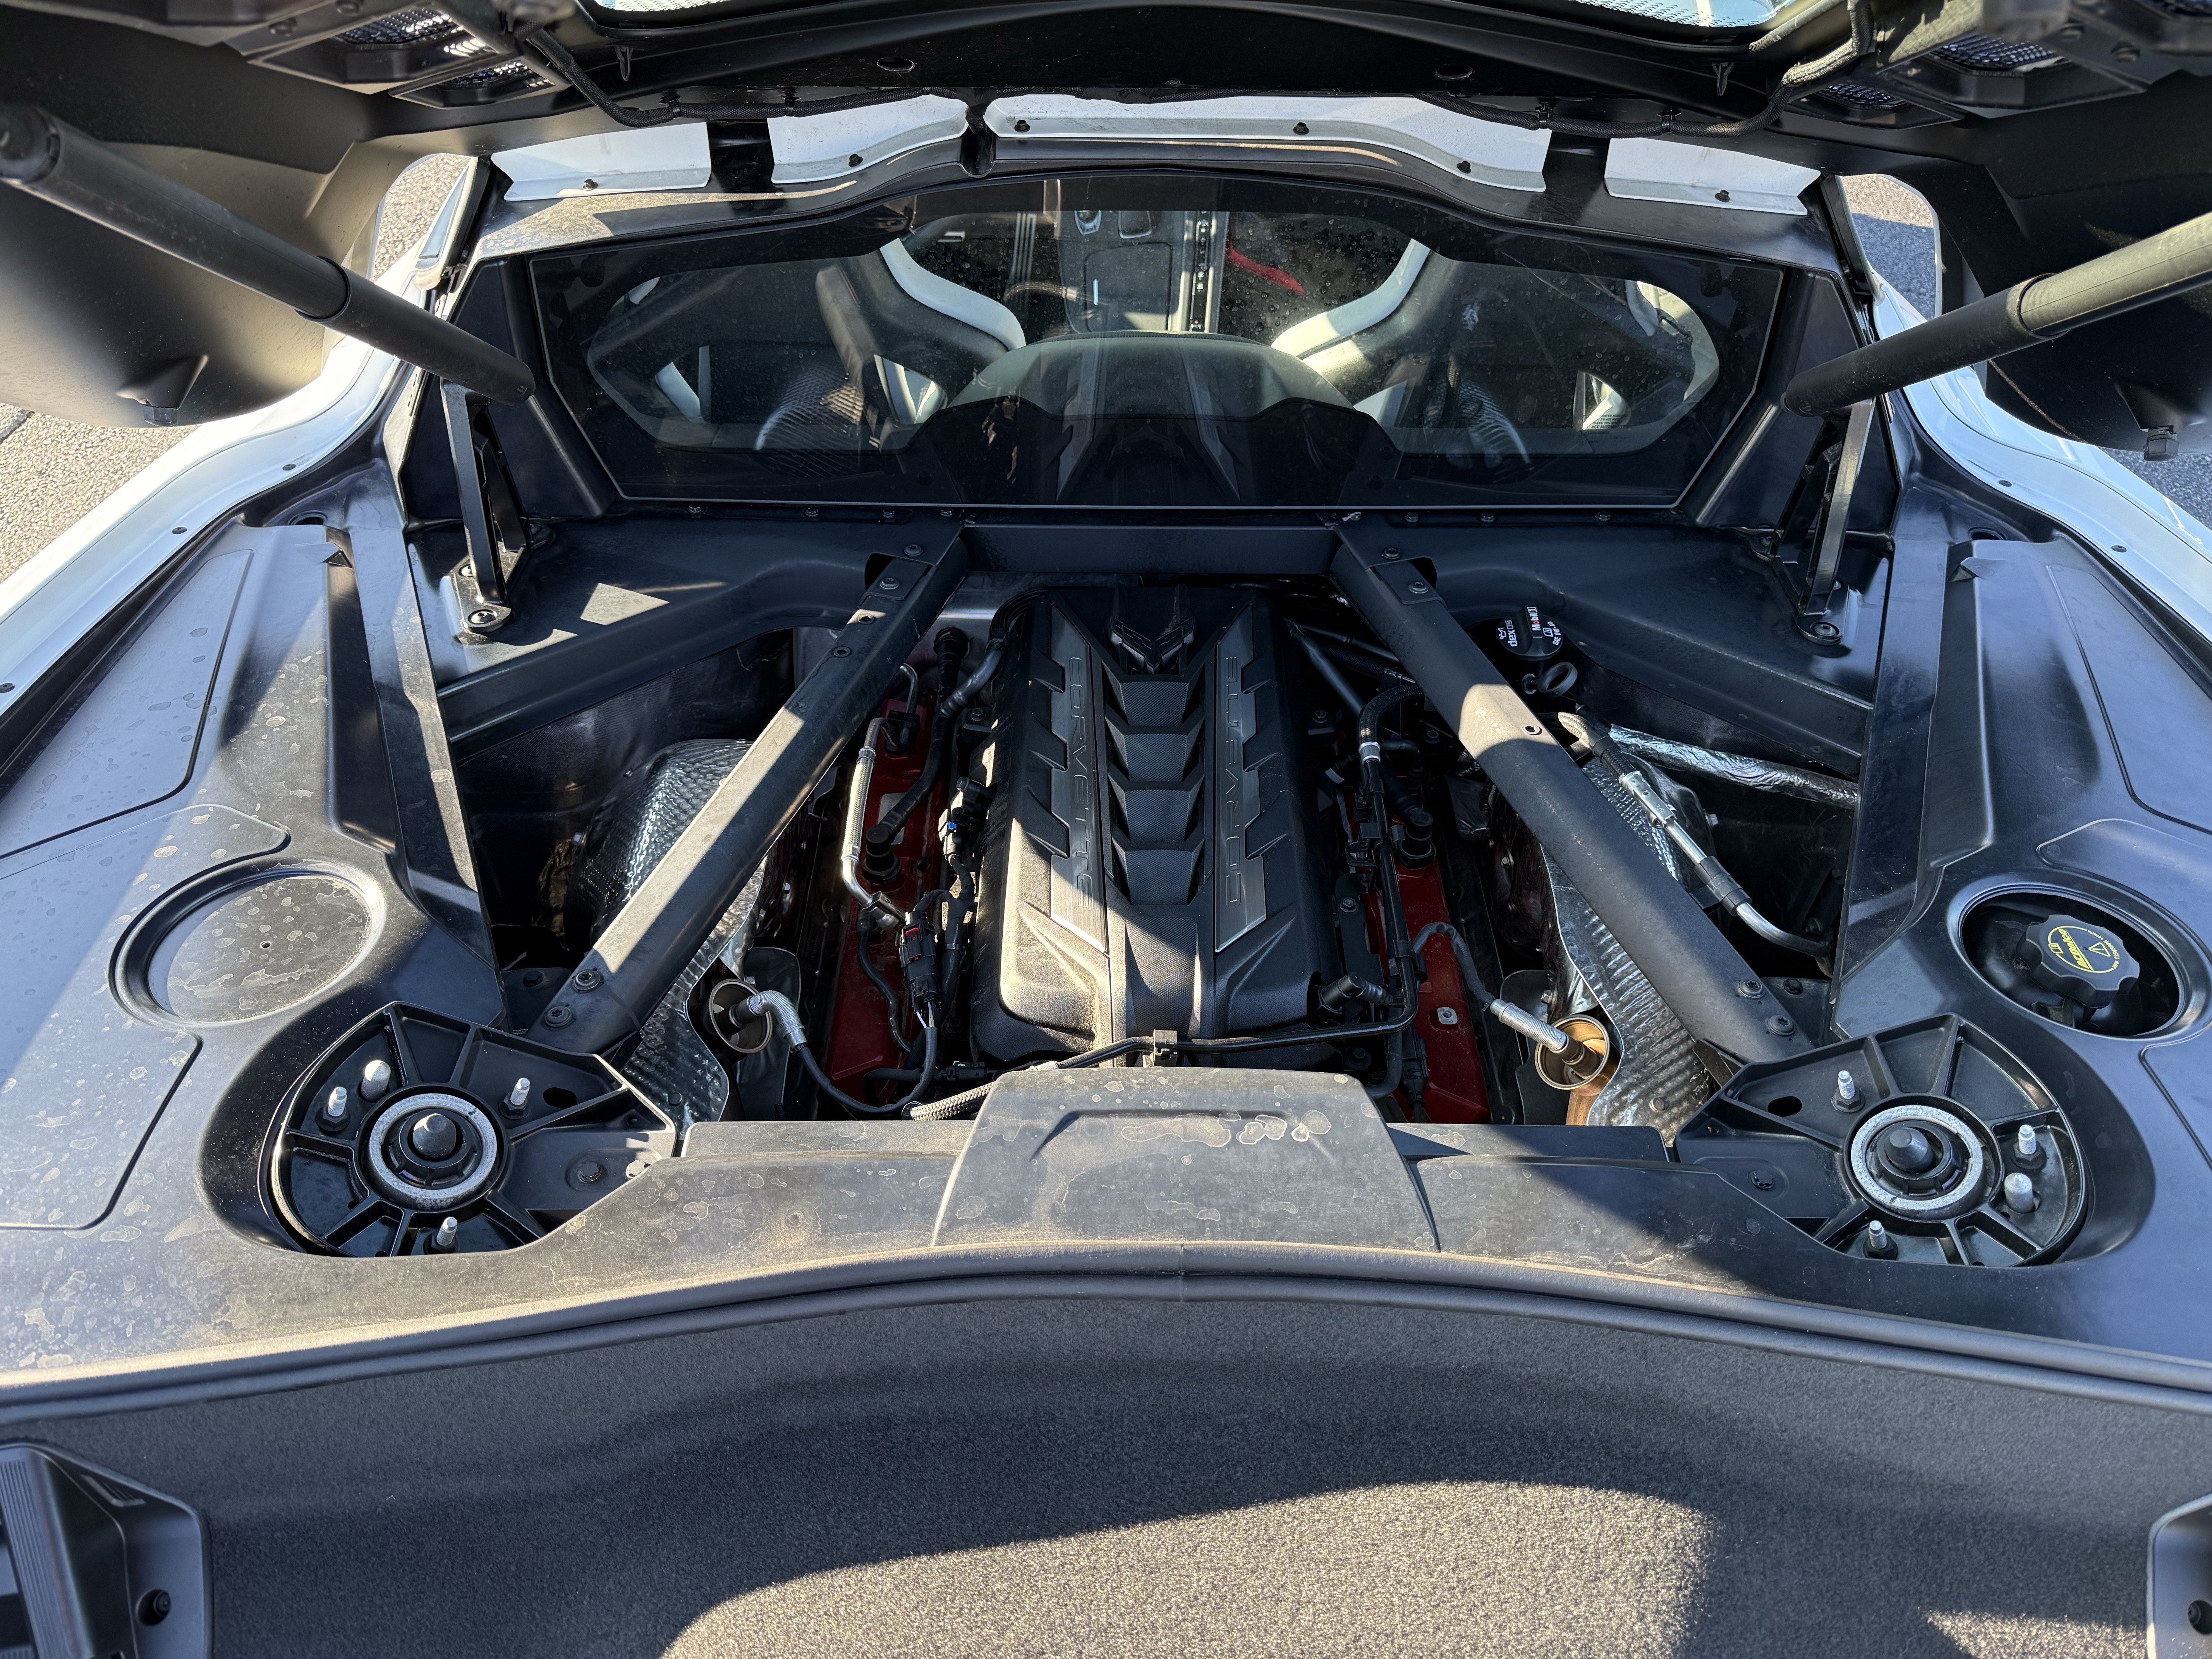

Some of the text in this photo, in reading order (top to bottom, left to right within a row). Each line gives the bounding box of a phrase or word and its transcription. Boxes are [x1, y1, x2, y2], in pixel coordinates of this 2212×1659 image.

[1505, 620, 1518, 647] dexos
[1529, 613, 1541, 631] Mobil
[1552, 636, 1561, 646] SAE
[1068, 656, 1093, 909] CORVETTE
[1225, 656, 1241, 908] CORVETTE
[2058, 928, 2090, 970] ACDelco
